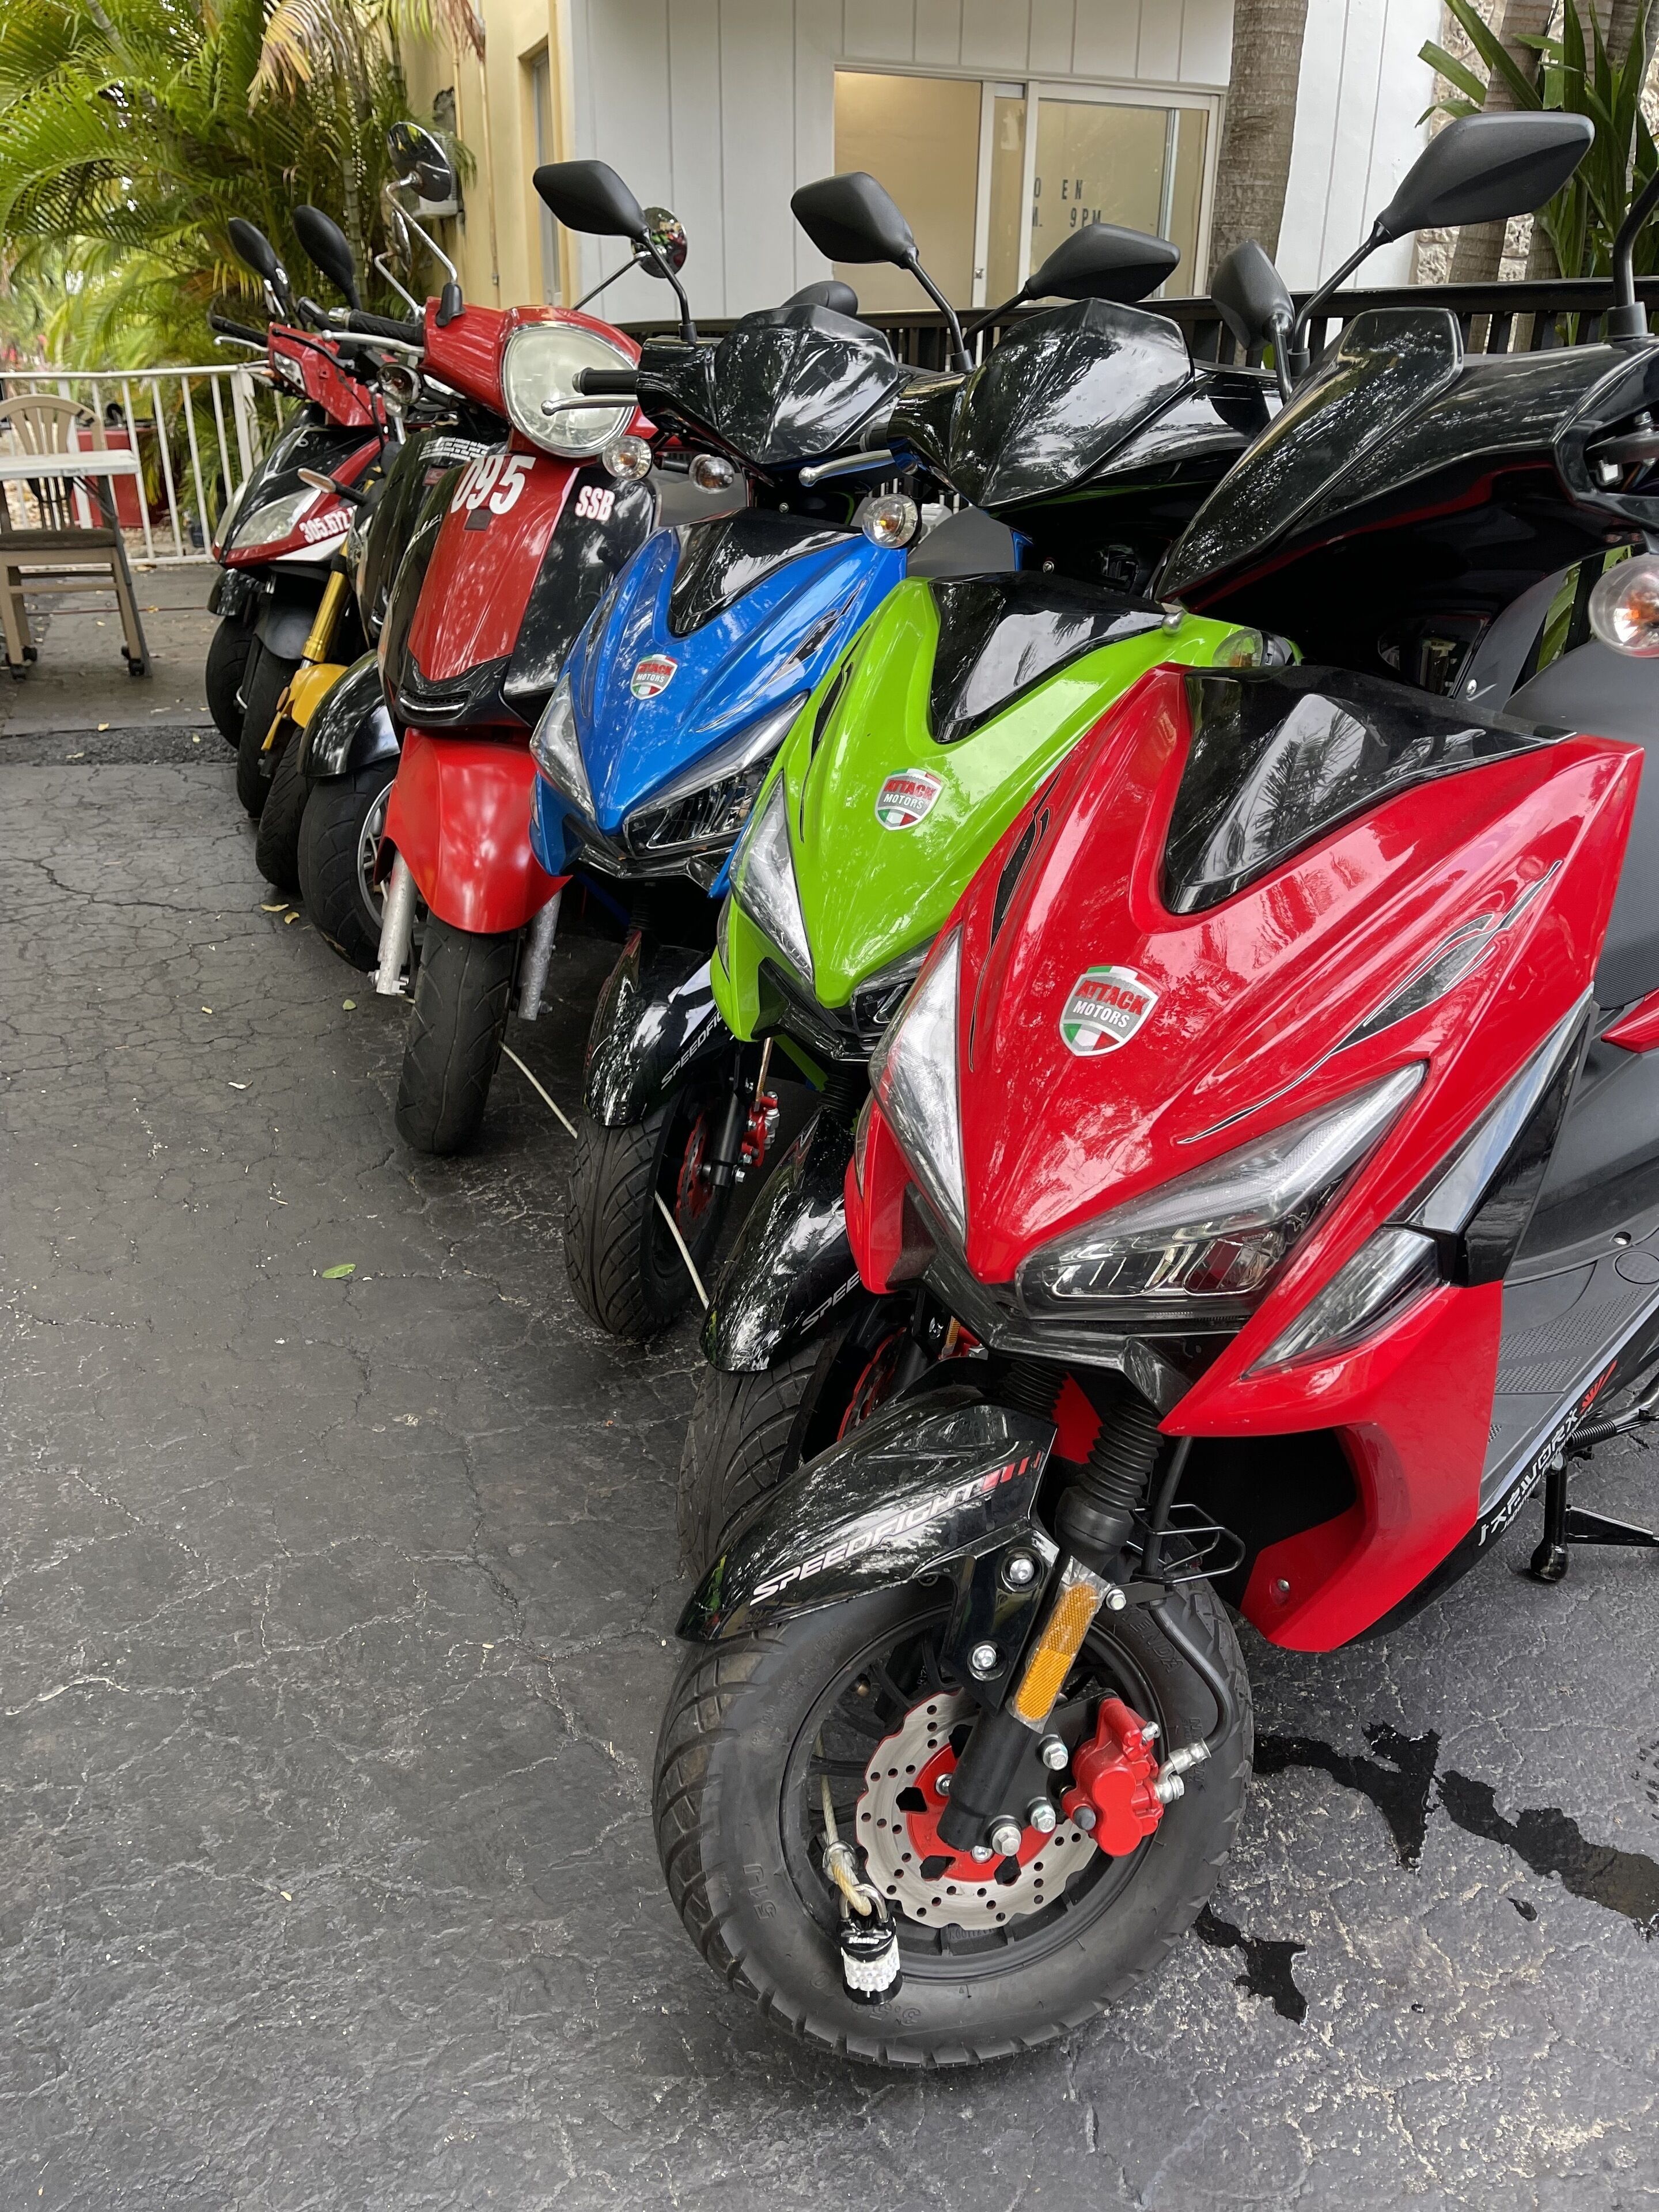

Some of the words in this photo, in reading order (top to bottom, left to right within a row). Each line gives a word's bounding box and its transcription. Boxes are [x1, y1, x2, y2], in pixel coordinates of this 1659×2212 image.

[450, 454, 536, 515] 095
[574, 485, 616, 521] SSB
[636, 673, 665, 683] MOTORS
[883, 794, 925, 810] MOTORS
[884, 779, 938, 801] ATTACK
[1072, 1001, 1130, 1028] MOTORS
[1075, 980, 1150, 1016] ATTACK
[800, 1271, 862, 1336] SPEE
[749, 1475, 986, 1607] SPEEDFIGHT
[1119, 1606, 1184, 1673] KENDA
[849, 1937, 880, 1945] Master
